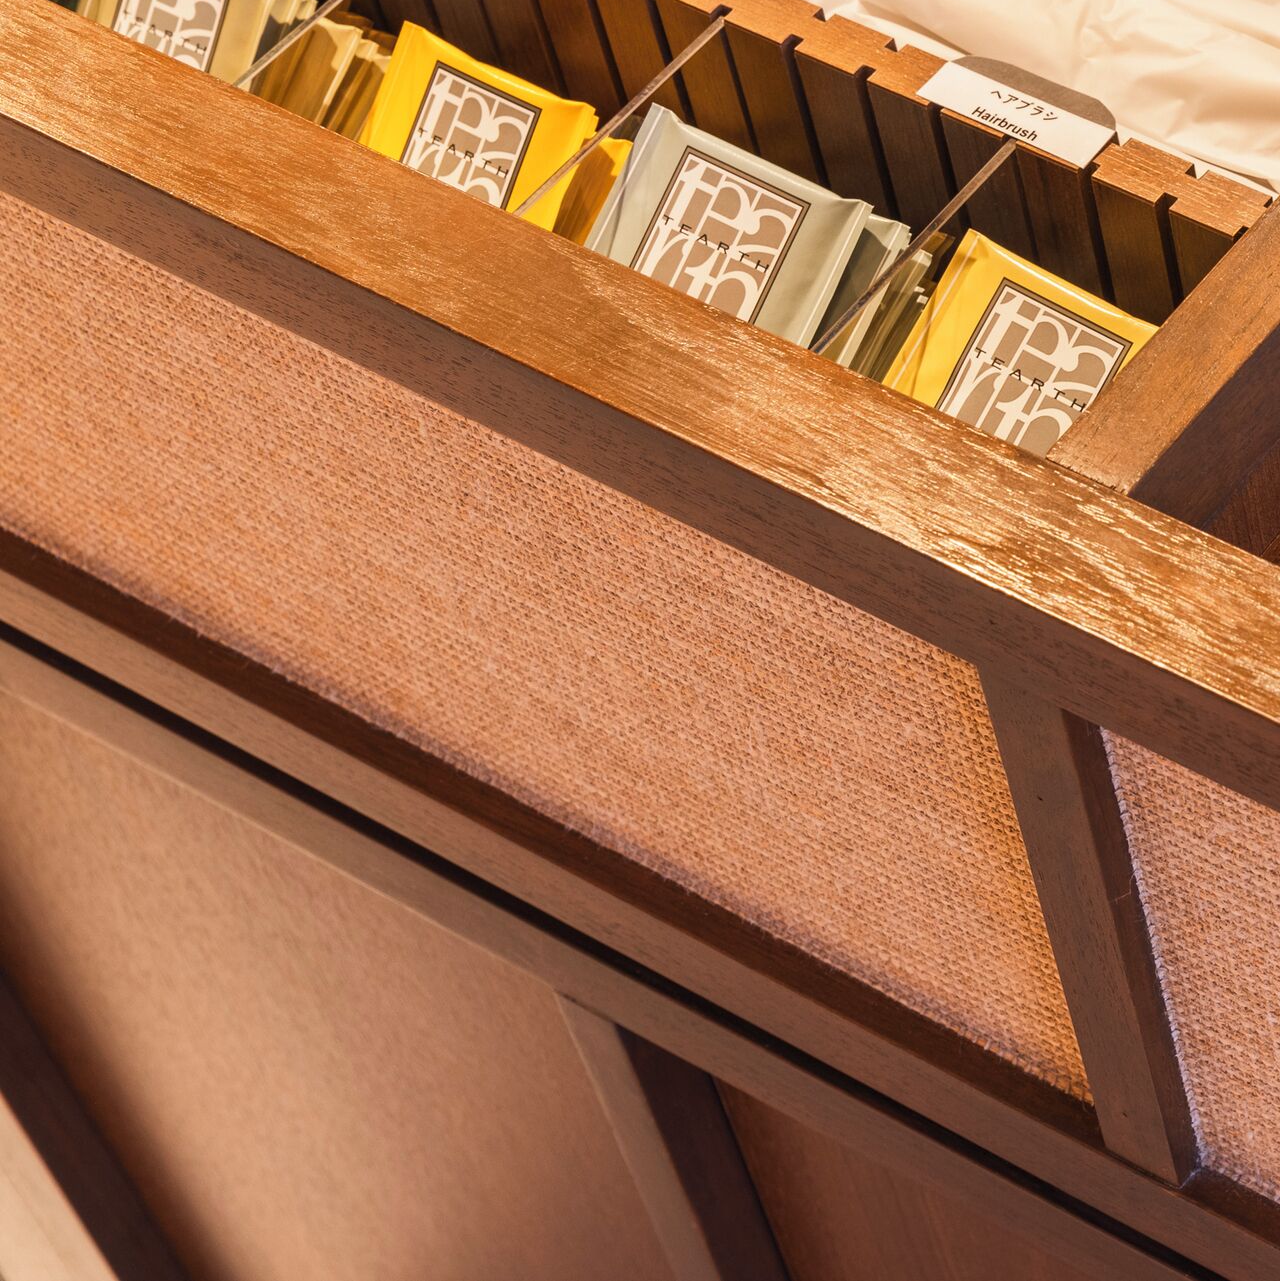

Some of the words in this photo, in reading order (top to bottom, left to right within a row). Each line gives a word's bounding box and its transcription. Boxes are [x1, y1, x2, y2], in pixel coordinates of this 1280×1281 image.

[971, 106, 1038, 141] Hairbrush
[990, 89, 1058, 121] ヘアブラシ
[417, 126, 509, 179] TEARTH
[662, 214, 770, 274] TEARTH
[974, 347, 1087, 413] TEARTH
